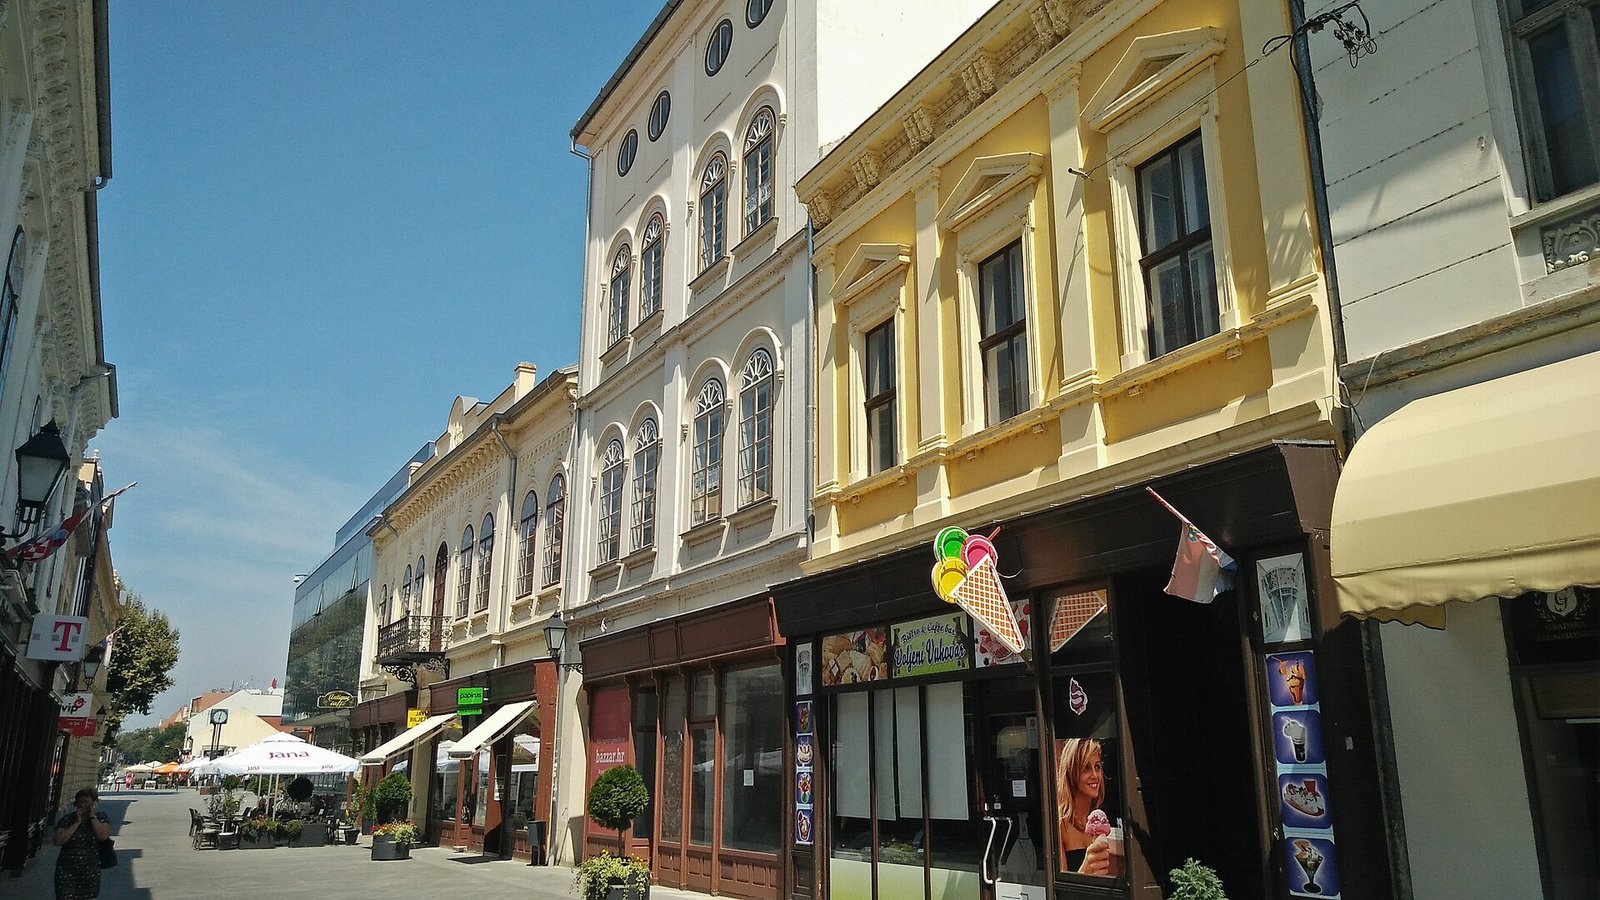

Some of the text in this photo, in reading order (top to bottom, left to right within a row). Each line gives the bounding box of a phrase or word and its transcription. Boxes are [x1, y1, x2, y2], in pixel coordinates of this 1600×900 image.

[54, 621, 81, 651] T
[894, 638, 967, 674] Voljeni Vukovar
[61, 703, 78, 714] vip
